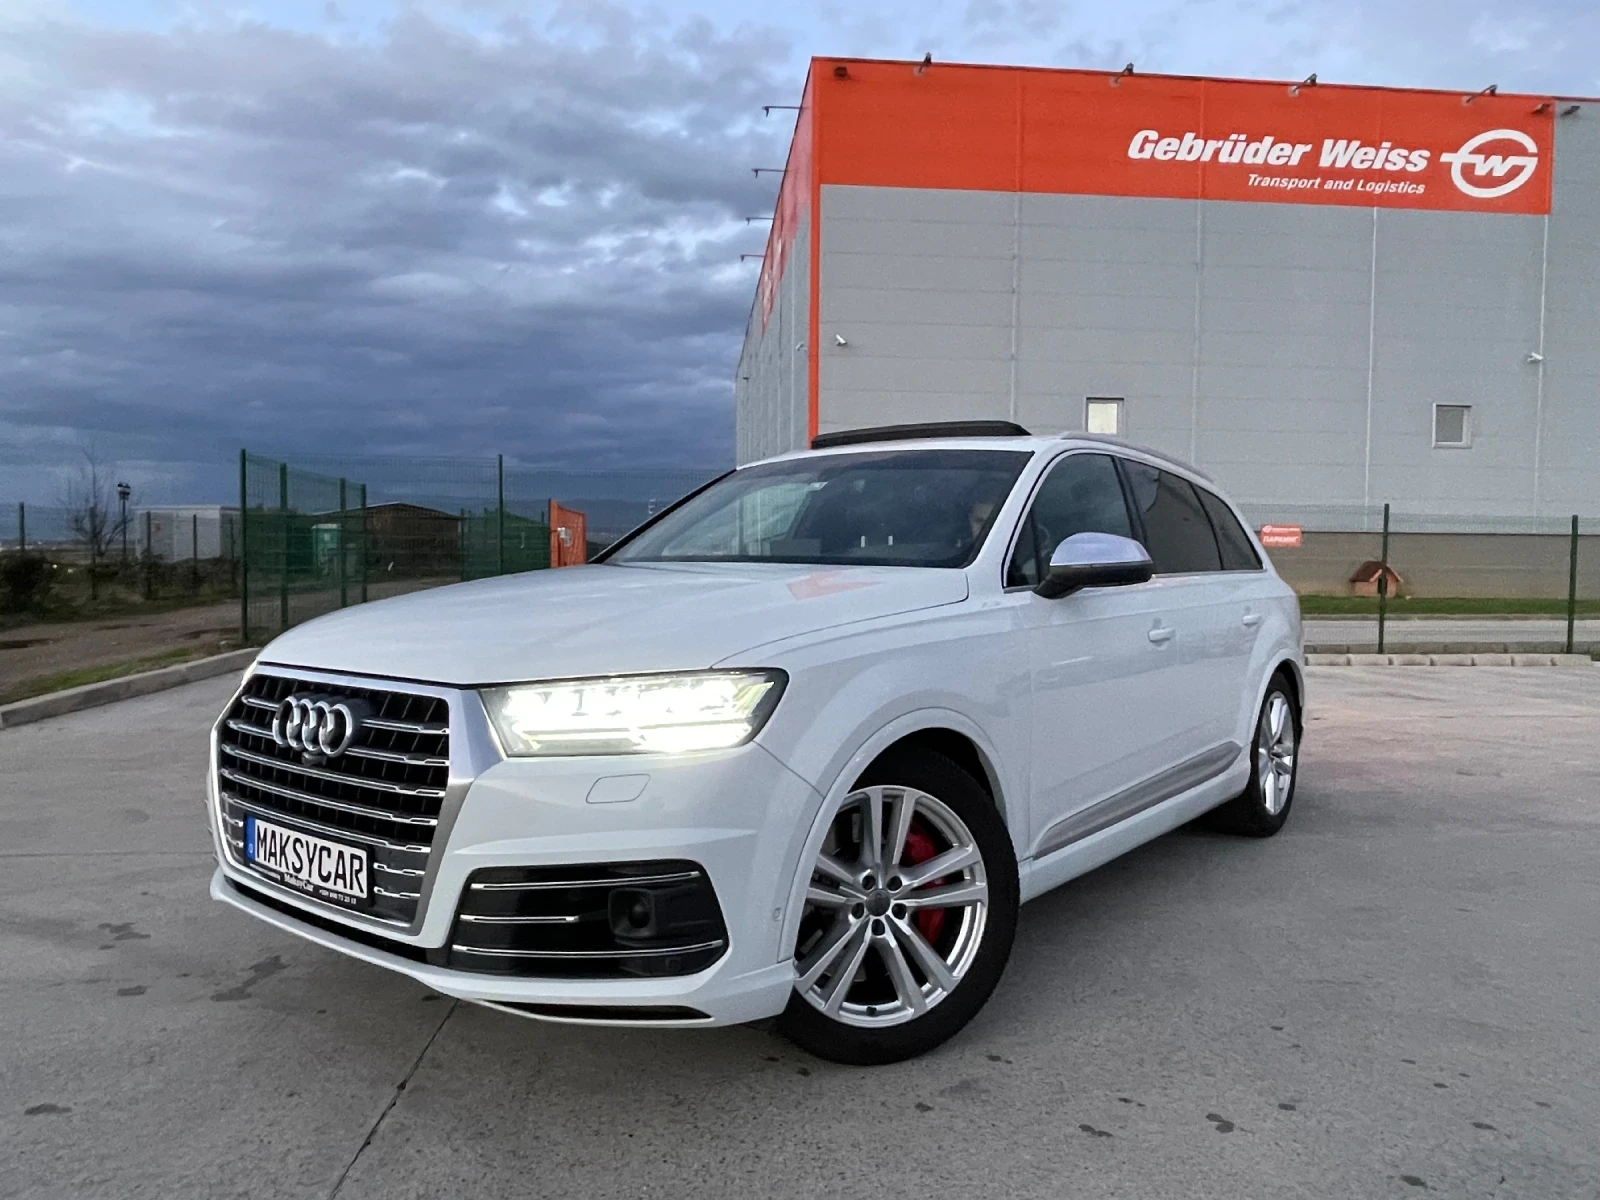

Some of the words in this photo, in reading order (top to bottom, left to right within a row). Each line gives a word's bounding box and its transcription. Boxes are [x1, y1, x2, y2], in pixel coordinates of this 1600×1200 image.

[1127, 129, 1313, 166] Gebrüder
[1318, 138, 1431, 172] Weiss
[1248, 173, 1321, 190] Transport
[1324, 178, 1354, 191] and
[1357, 179, 1426, 194] Logistics
[257, 825, 365, 894] MAKSYCAR
